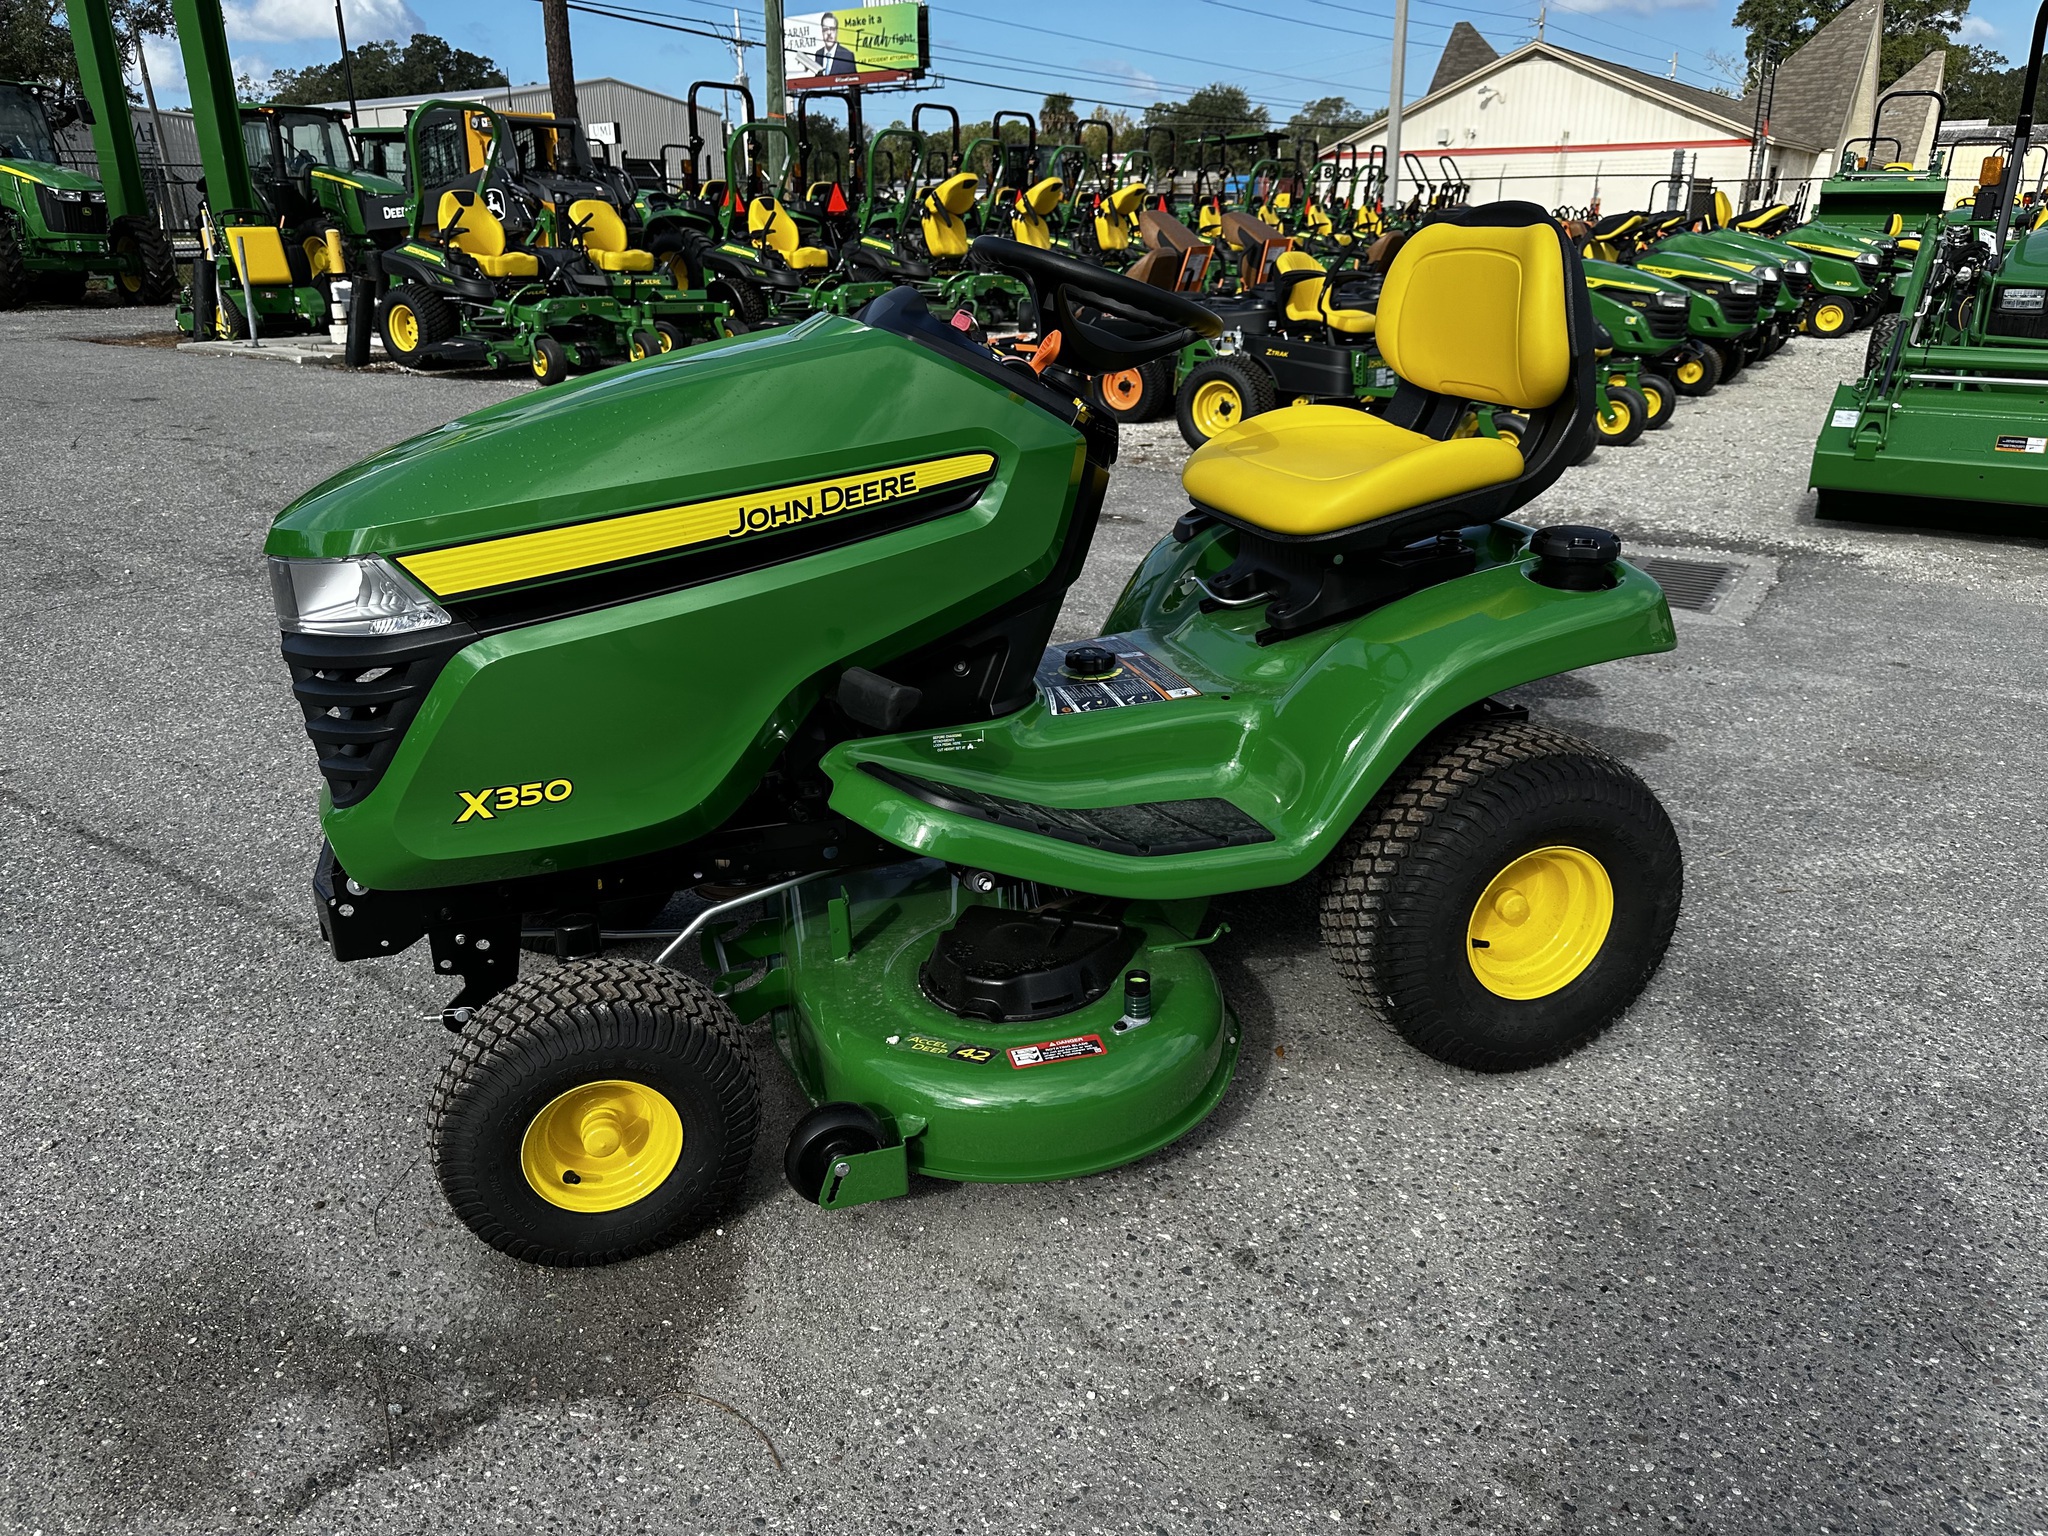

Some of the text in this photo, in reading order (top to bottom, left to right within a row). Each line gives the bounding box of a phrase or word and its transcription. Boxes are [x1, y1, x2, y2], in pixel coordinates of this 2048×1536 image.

[844, 17, 866, 27] Make
[868, 17, 876, 25] it
[856, 27, 890, 52] Farah
[728, 471, 918, 537] JOHN DEERE
[451, 777, 575, 826] X350
[907, 1036, 948, 1050] ACCEL
[1056, 1037, 1083, 1045] DANGER
[911, 1043, 949, 1055] DEEP
[956, 1047, 992, 1063] 42
